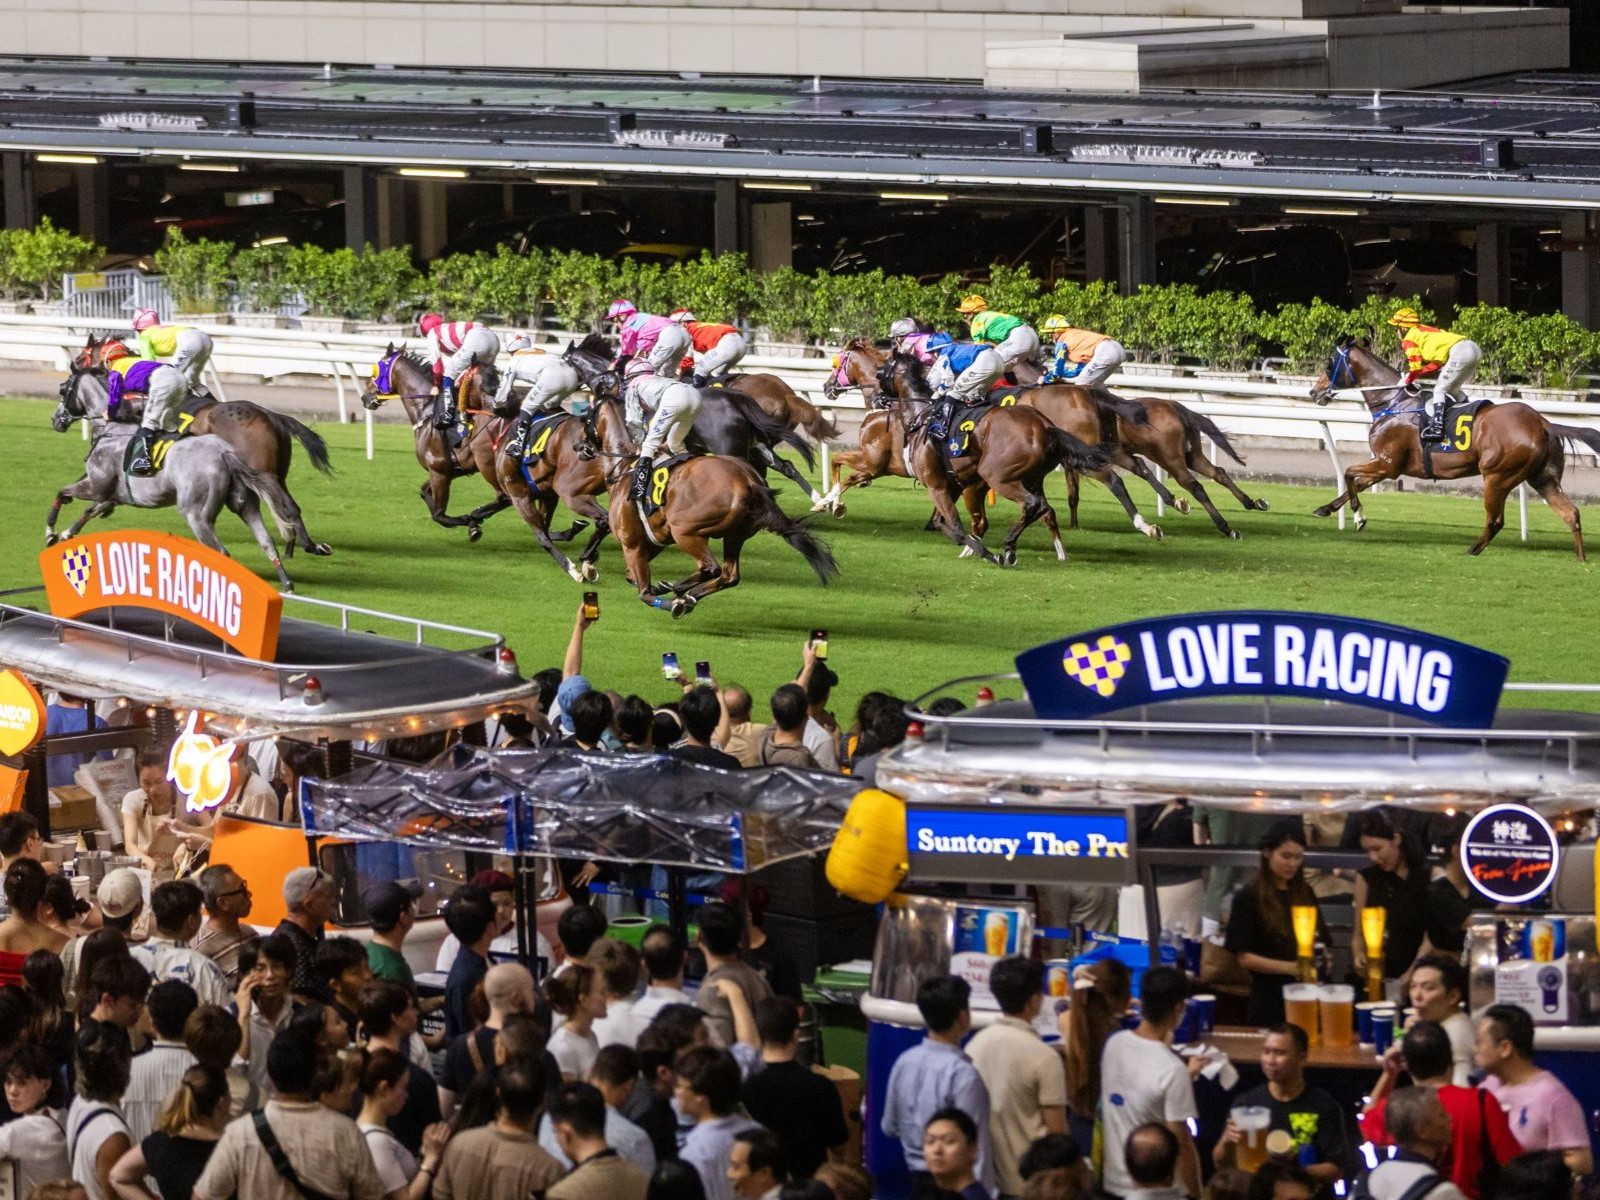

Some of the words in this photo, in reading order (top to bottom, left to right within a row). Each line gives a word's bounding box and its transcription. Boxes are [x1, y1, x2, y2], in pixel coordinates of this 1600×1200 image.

[178, 412, 194, 433] 7
[1455, 415, 1473, 451] 5
[152, 440, 175, 469] 11
[531, 427, 552, 455] 4
[652, 467, 669, 505] 8
[95, 542, 154, 598] LOVE
[157, 547, 243, 637] RACING
[1139, 623, 1263, 693] LOVE
[1273, 624, 1454, 713] RACING
[917, 827, 1021, 862] Suntory
[1026, 831, 1080, 857] The
